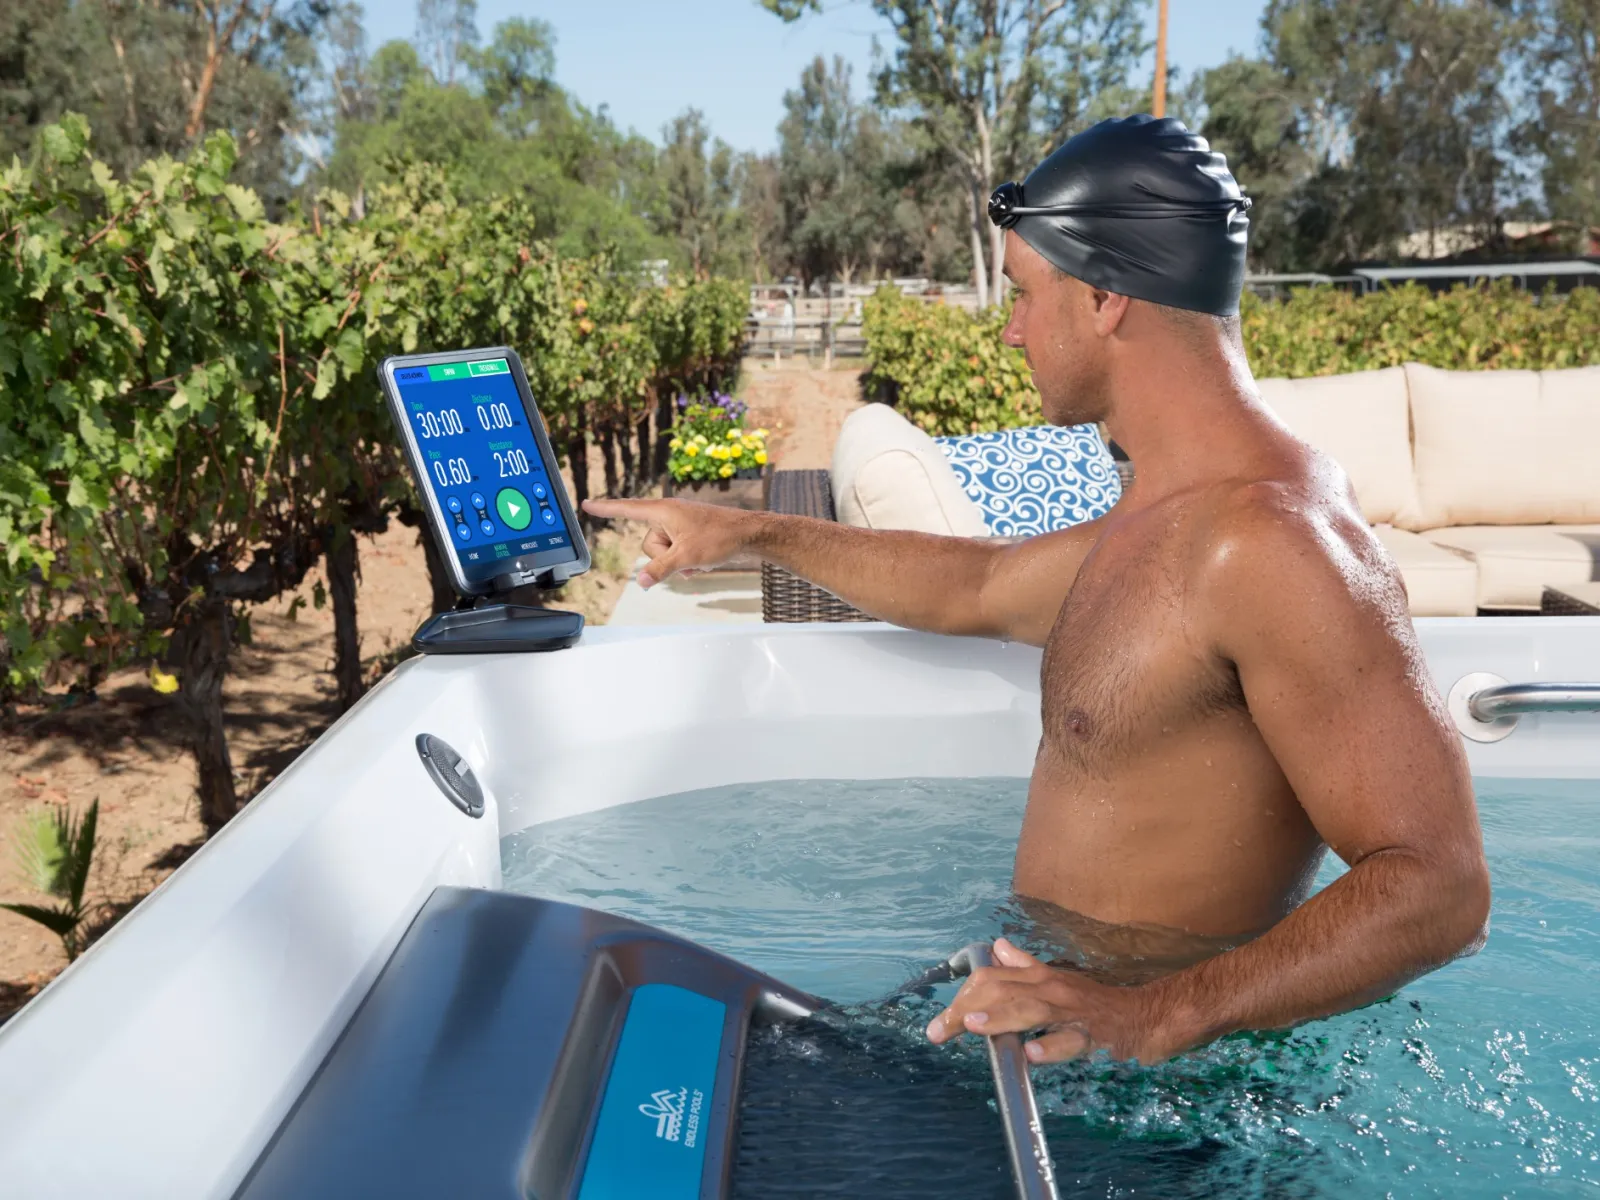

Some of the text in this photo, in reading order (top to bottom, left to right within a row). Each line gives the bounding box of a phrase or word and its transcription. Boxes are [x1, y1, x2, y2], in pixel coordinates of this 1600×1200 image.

[417, 409, 463, 438] 30:00
[477, 403, 512, 430] 0.00
[434, 458, 471, 486] 0.60
[493, 449, 529, 478] 2:00
[685, 1090, 703, 1147] ENDLESS POOLS
